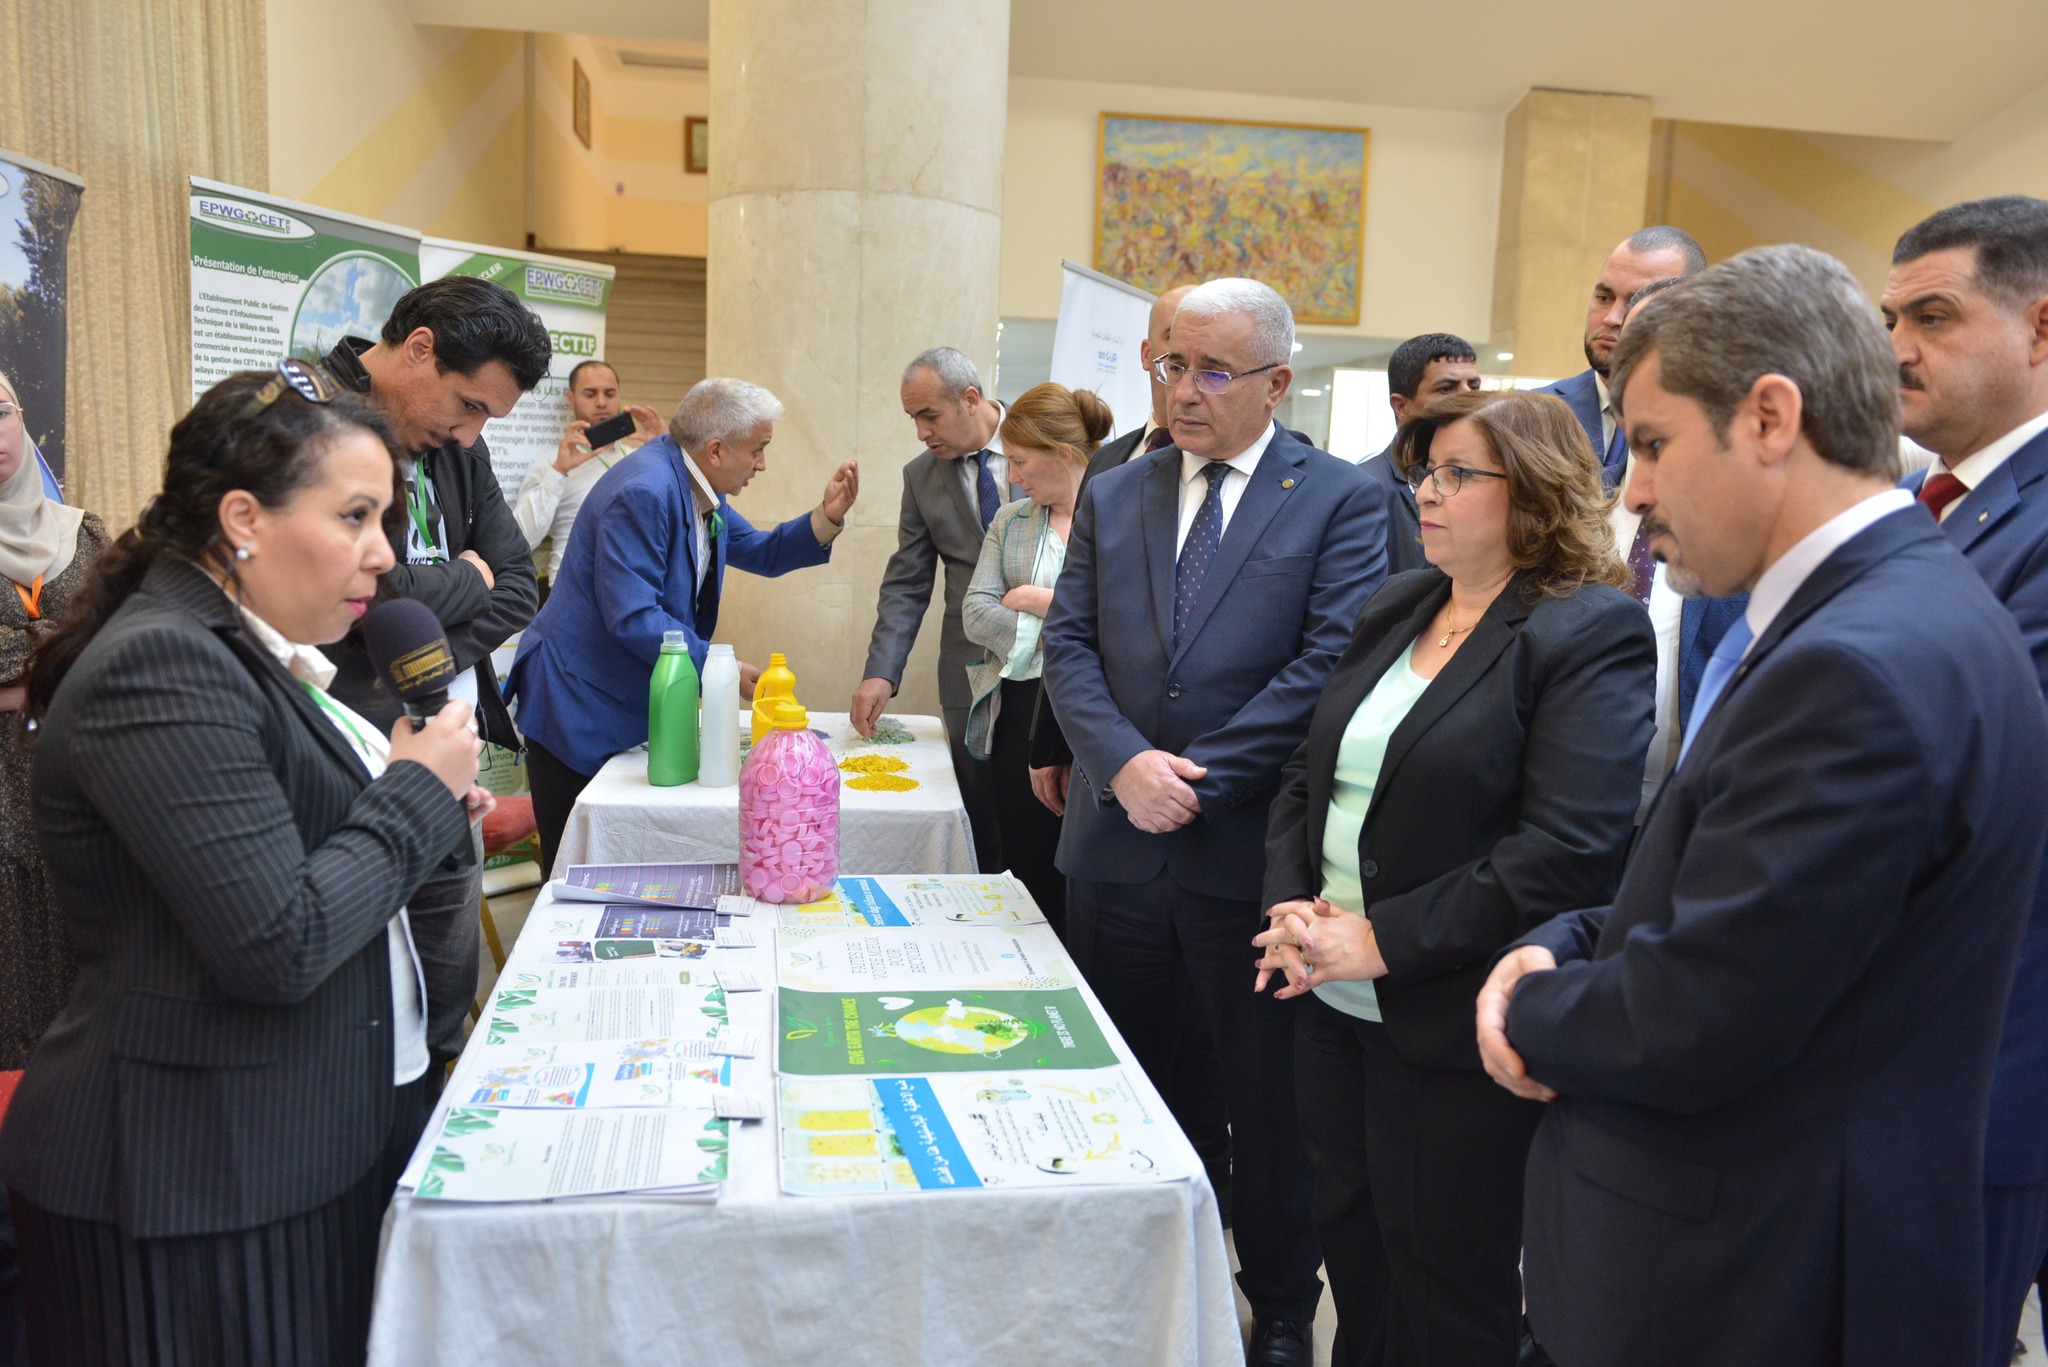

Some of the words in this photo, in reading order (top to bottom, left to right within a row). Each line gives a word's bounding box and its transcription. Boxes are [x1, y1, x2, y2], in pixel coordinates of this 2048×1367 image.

[194, 255, 245, 273] Présentation
[247, 264, 257, 275] de
[258, 266, 299, 283] l'entreprise
[193, 303, 204, 312] des
[205, 305, 228, 315] Centres
[199, 292, 243, 306] L'Etablissement
[243, 299, 260, 309] Public
[269, 303, 289, 312] Gestion
[193, 316, 224, 328] Technique
[225, 320, 232, 328] de
[239, 321, 258, 332] Wilaya
[267, 326, 280, 334] Blida
[194, 341, 231, 352] commerciale
[232, 345, 239, 353] et
[258, 337, 284, 346] caractère
[551, 333, 596, 353] ECTIF
[194, 353, 203, 361] de
[210, 355, 231, 364] gestion
[232, 357, 242, 365] des
[243, 358, 258, 367] CET's
[267, 360, 273, 368] la
[194, 366, 214, 375] wilaya
[519, 412, 559, 421] rationnelle
[486, 422, 512, 430] donner
[531, 424, 560, 433] seconde
[536, 435, 559, 446] périod
[886, 948, 905, 966] POUR
[903, 942, 927, 974] RECYCLER
[841, 998, 860, 1019] CHANCE
[848, 1049, 866, 1065] GIVE
